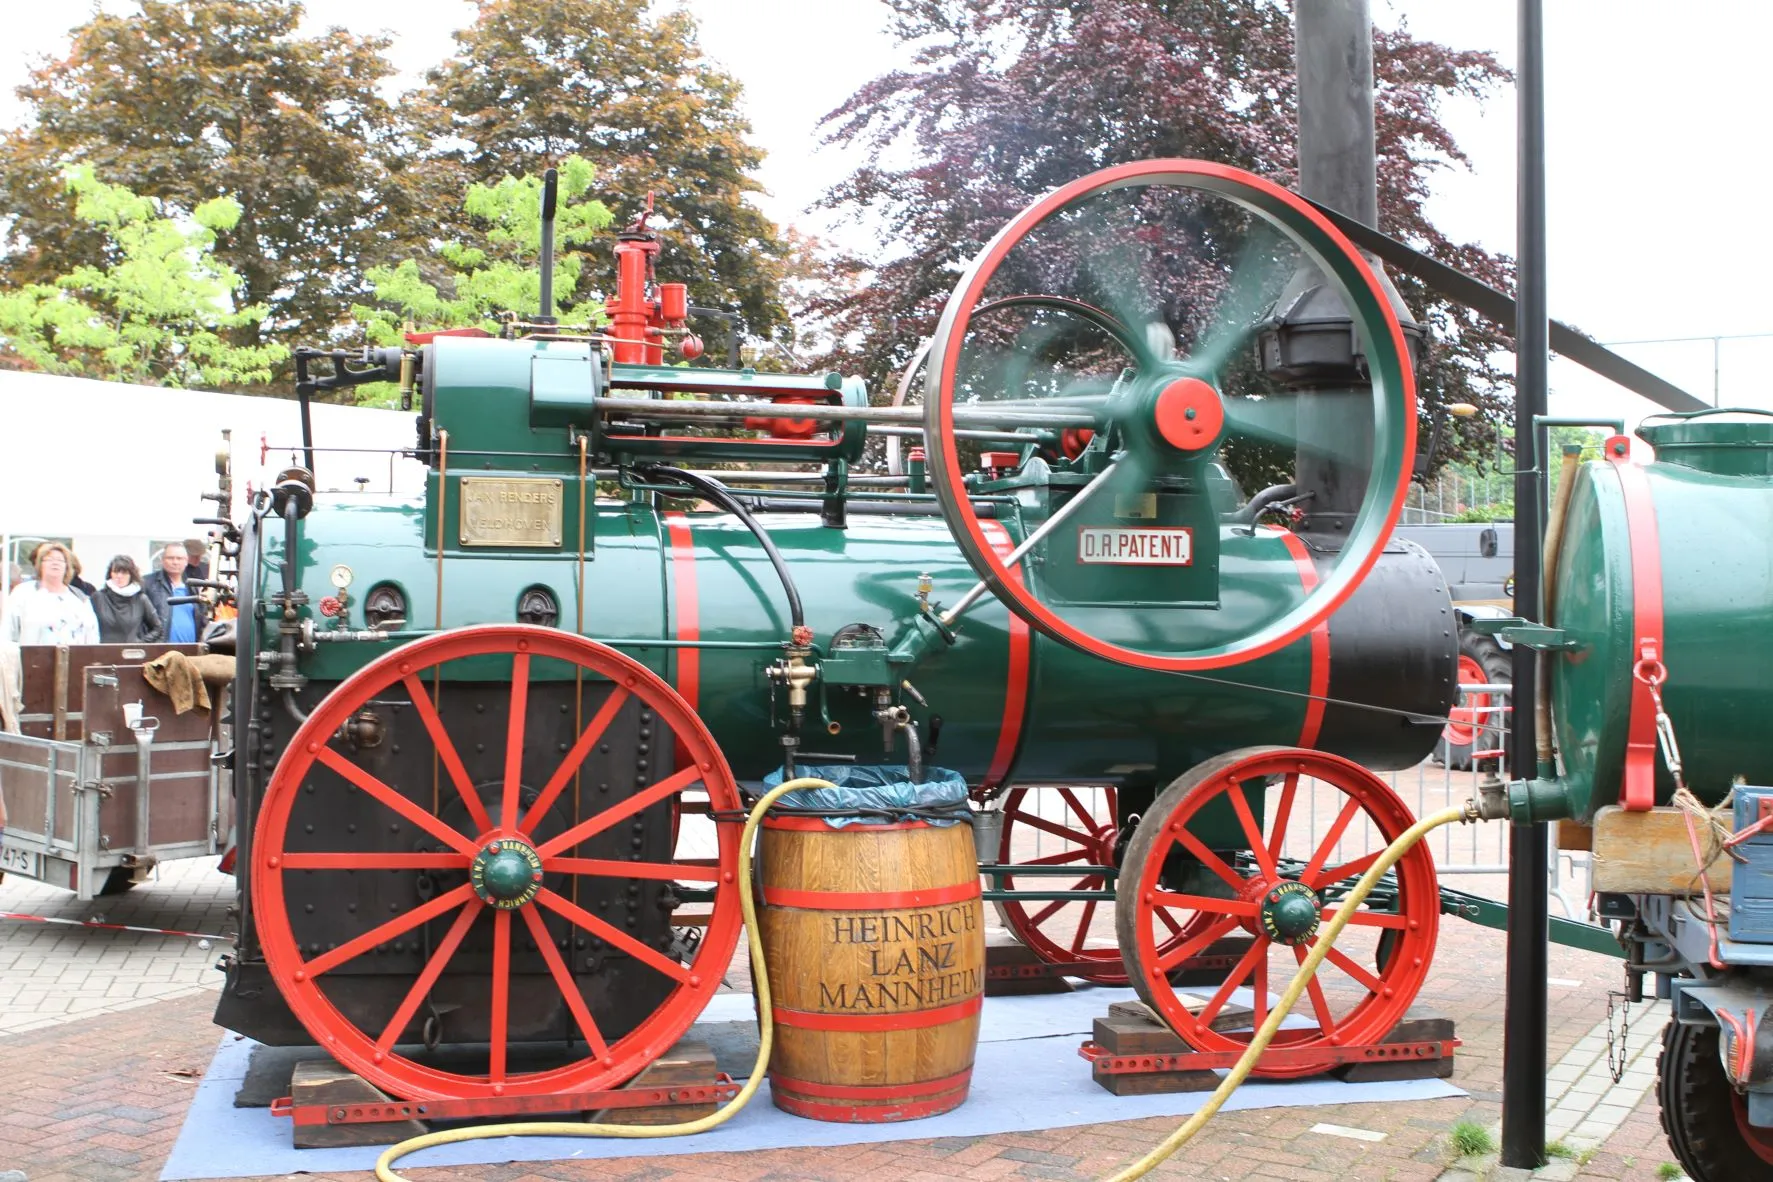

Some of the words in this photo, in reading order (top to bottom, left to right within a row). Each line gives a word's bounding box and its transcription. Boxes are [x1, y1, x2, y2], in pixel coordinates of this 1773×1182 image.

[499, 491, 556, 505] RENDERS
[832, 903, 977, 945] HEINRICH
[870, 942, 957, 977] LANZ
[819, 964, 983, 1010] MANNHEIM
